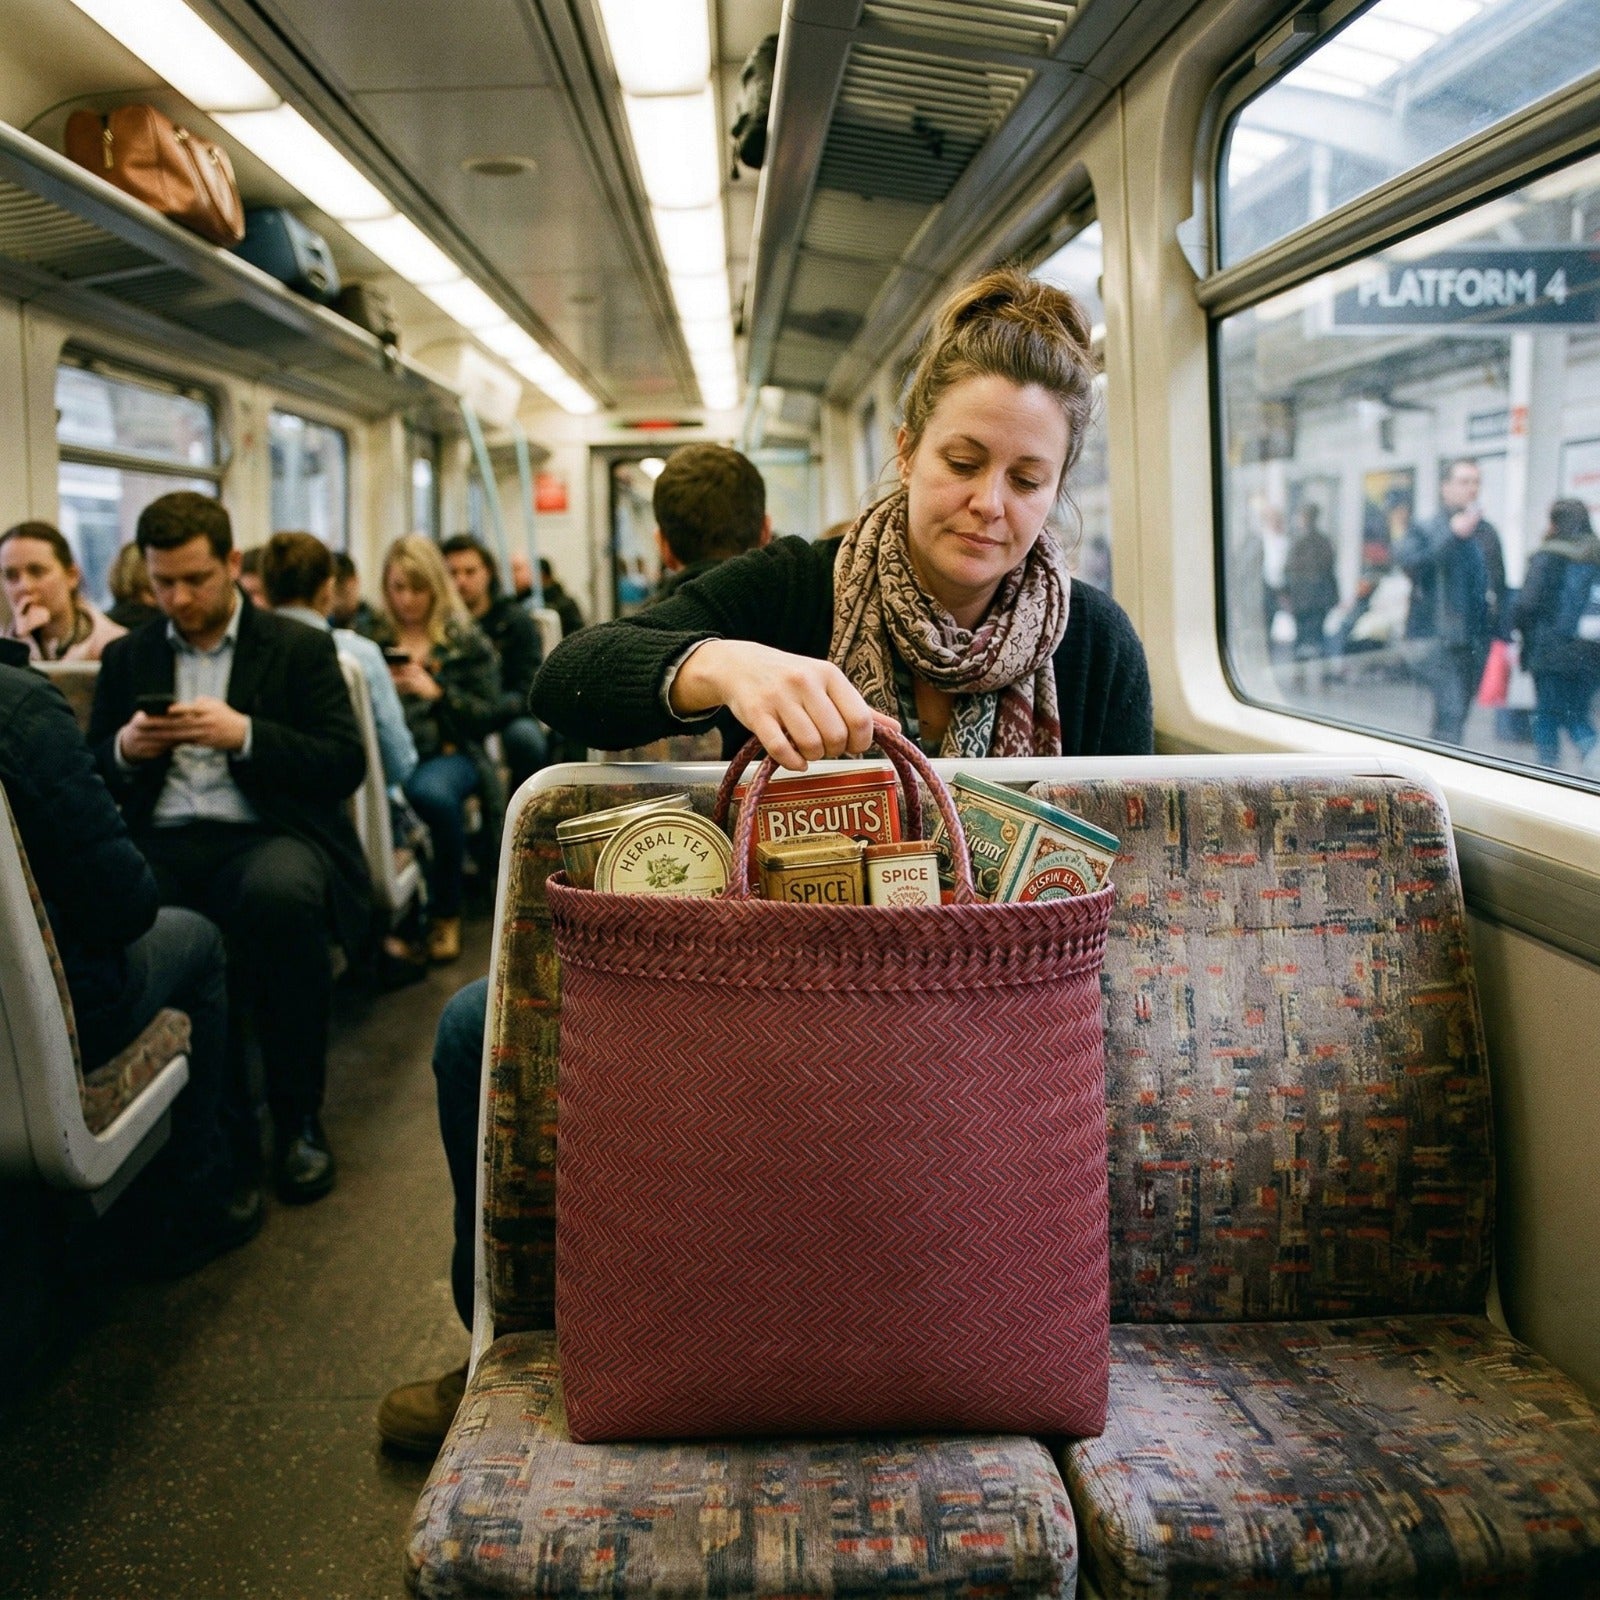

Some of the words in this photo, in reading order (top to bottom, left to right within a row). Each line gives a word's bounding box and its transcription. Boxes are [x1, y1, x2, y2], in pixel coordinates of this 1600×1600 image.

[1357, 267, 1537, 307] PLATFORM
[1543, 267, 1567, 306] 4
[767, 800, 882, 842] BISCUITS
[620, 831, 675, 872] HERBAL
[682, 834, 710, 862] TEA
[790, 880, 849, 902] SPICE
[882, 868, 928, 883] SPICE
